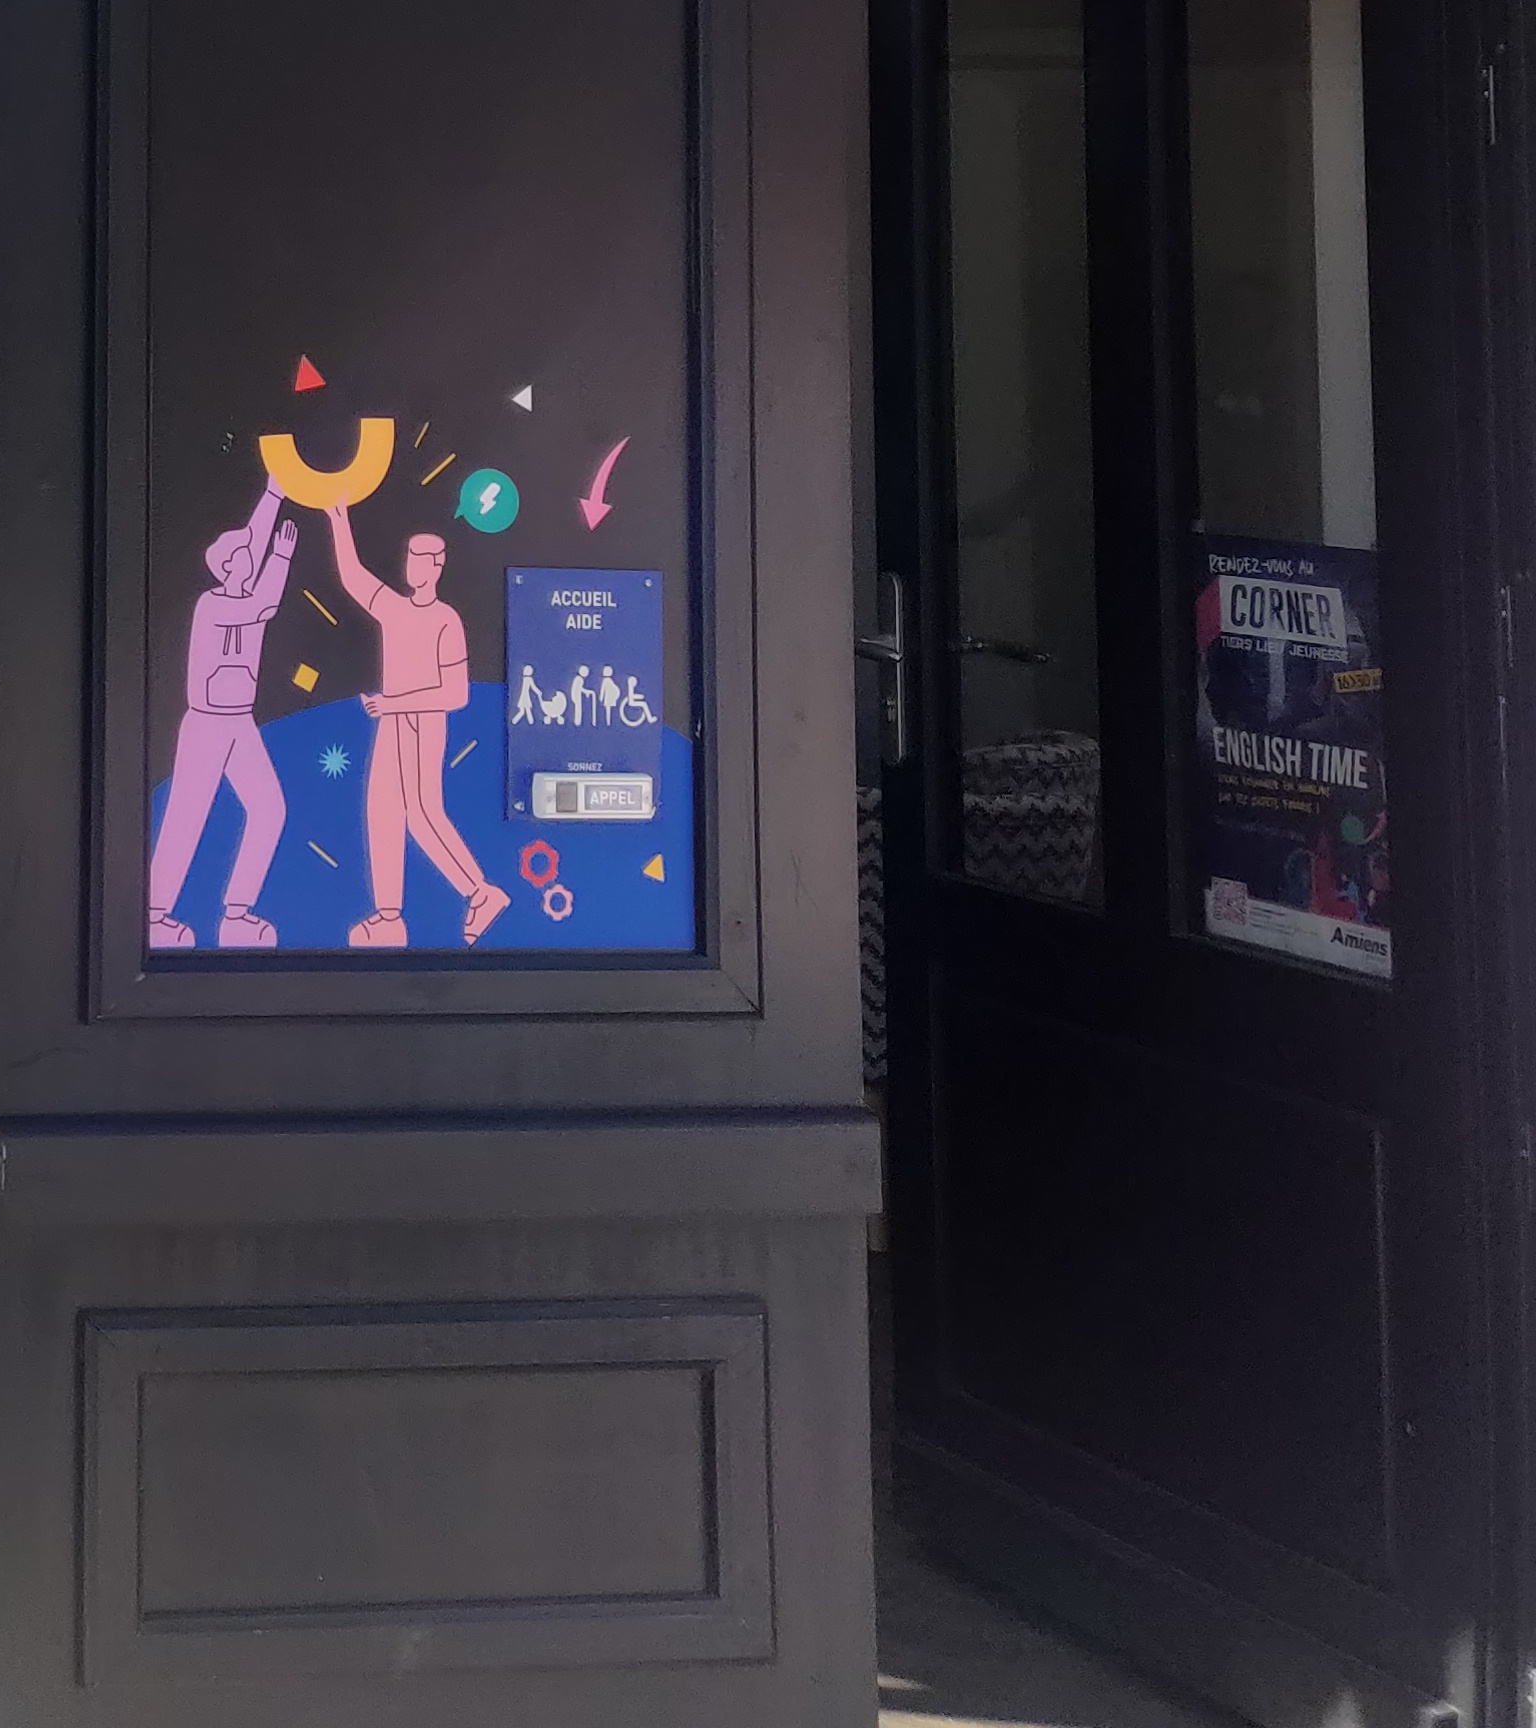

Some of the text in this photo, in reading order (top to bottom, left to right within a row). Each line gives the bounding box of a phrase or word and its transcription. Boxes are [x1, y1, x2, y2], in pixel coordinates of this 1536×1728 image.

[550, 589, 618, 609] ACCUEIL
[1230, 584, 1337, 639] CORNER
[565, 613, 603, 630] AIDE
[1212, 726, 1302, 778] ENGLISH
[1307, 741, 1369, 789] TIME
[589, 789, 636, 806] APPEL
[1330, 927, 1389, 957] Amiens
